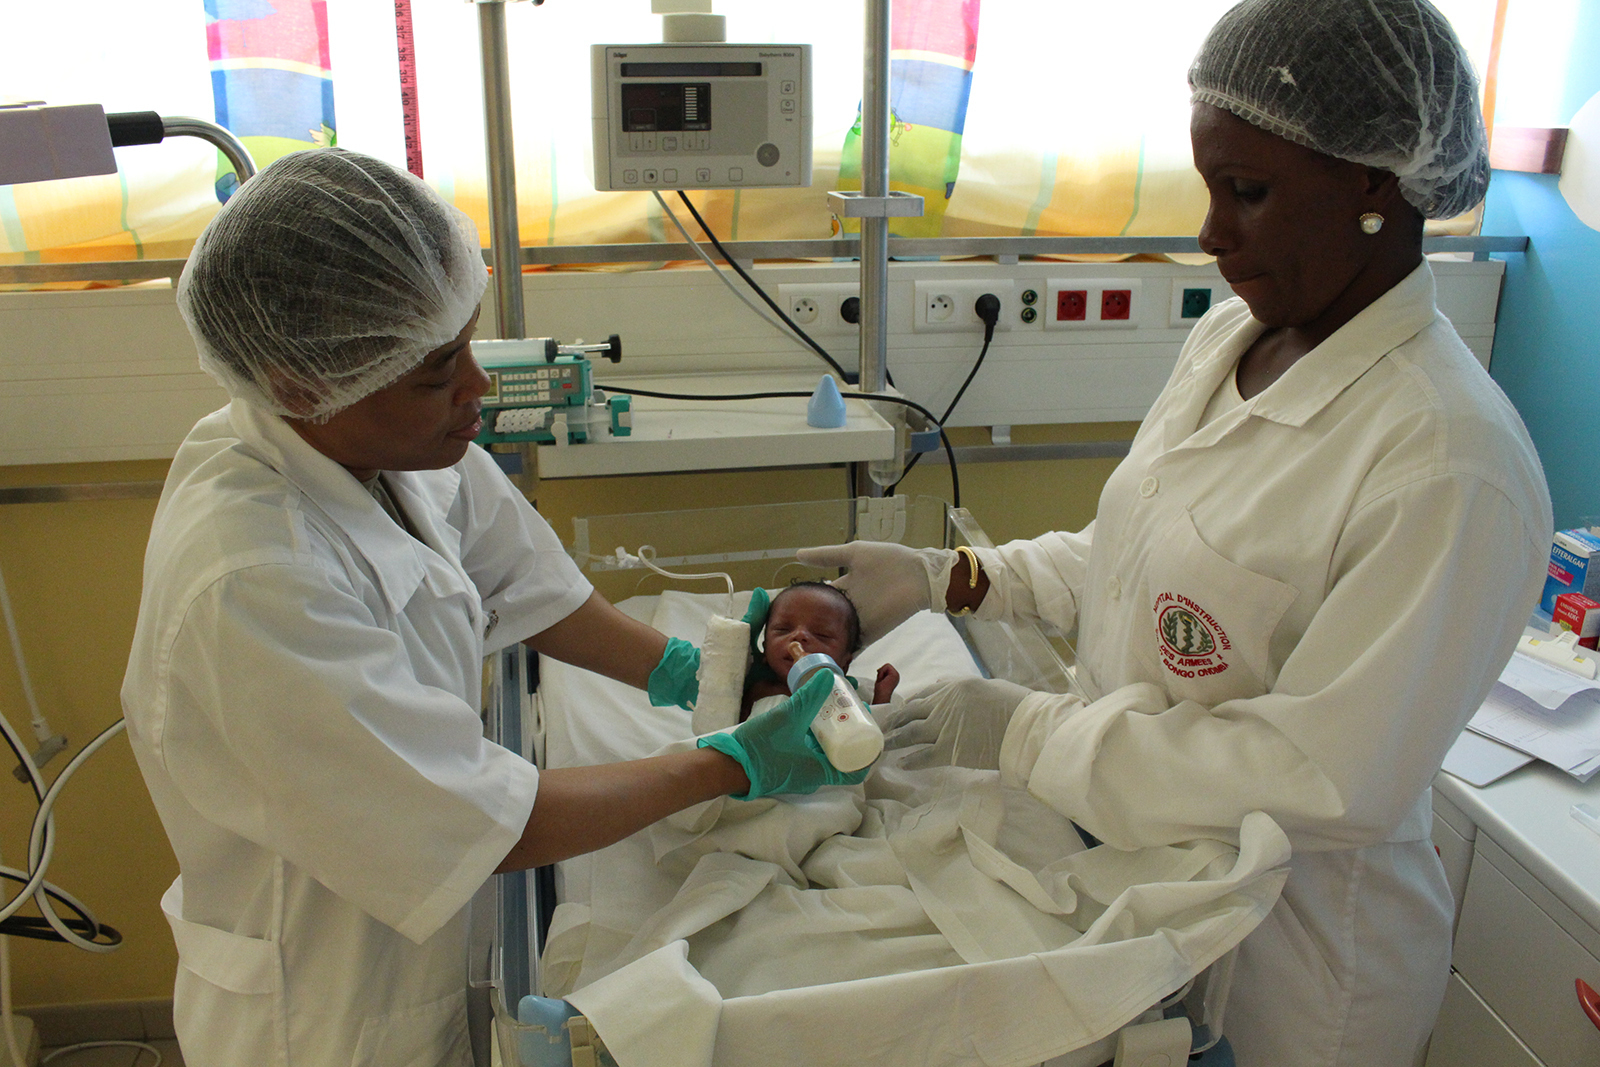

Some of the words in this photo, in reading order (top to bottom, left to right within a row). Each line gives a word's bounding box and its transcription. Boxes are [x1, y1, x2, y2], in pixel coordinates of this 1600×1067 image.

[395, 2, 403, 17] 36
[396, 25, 405, 39] 37
[398, 47, 406, 62] 38
[399, 69, 408, 84] 39
[401, 91, 409, 106] 40
[403, 113, 411, 126] 41
[405, 135, 412, 149] 42
[1552, 546, 1586, 569] EFFERALGAN
[1160, 645, 1175, 661] DES
[1163, 658, 1195, 678] BONGO
